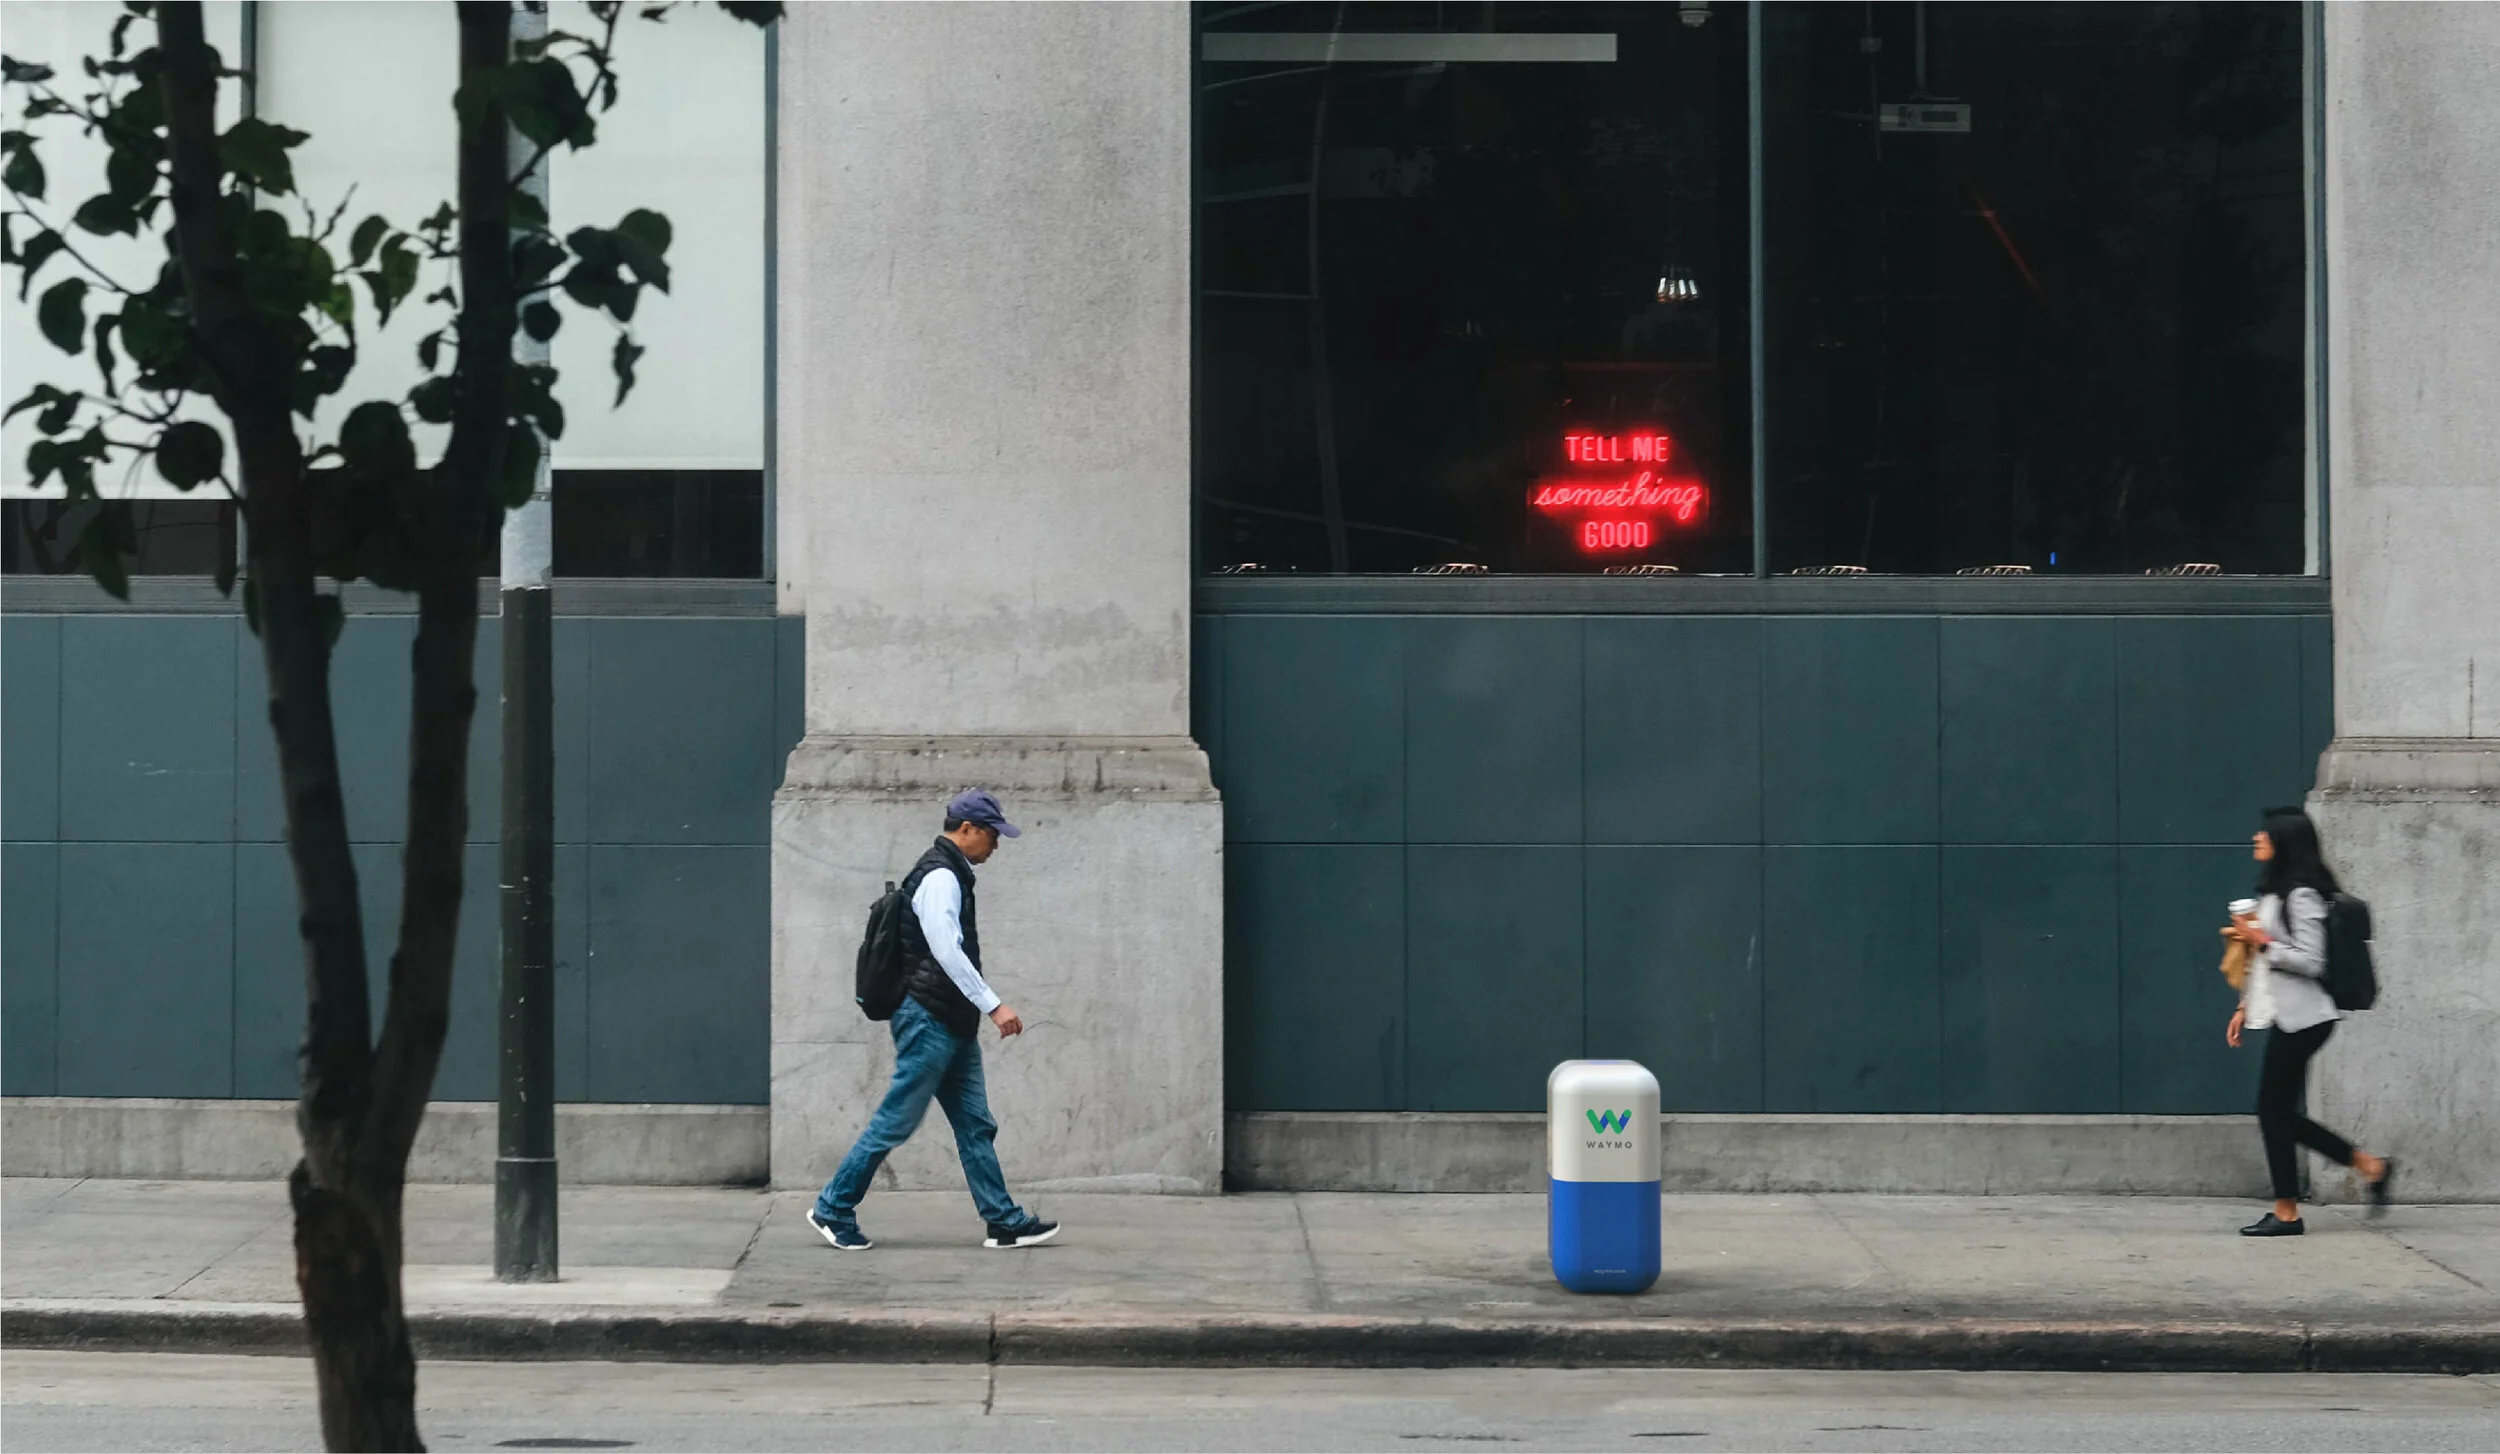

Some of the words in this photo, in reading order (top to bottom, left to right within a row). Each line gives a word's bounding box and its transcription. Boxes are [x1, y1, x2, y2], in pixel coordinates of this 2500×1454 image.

[1564, 435, 1625, 462] TELL
[1632, 435, 1669, 462] ME
[1533, 470, 1703, 520] something
[1583, 520, 1650, 548] GOOD
[1586, 1140, 1633, 1149] WAYMO
